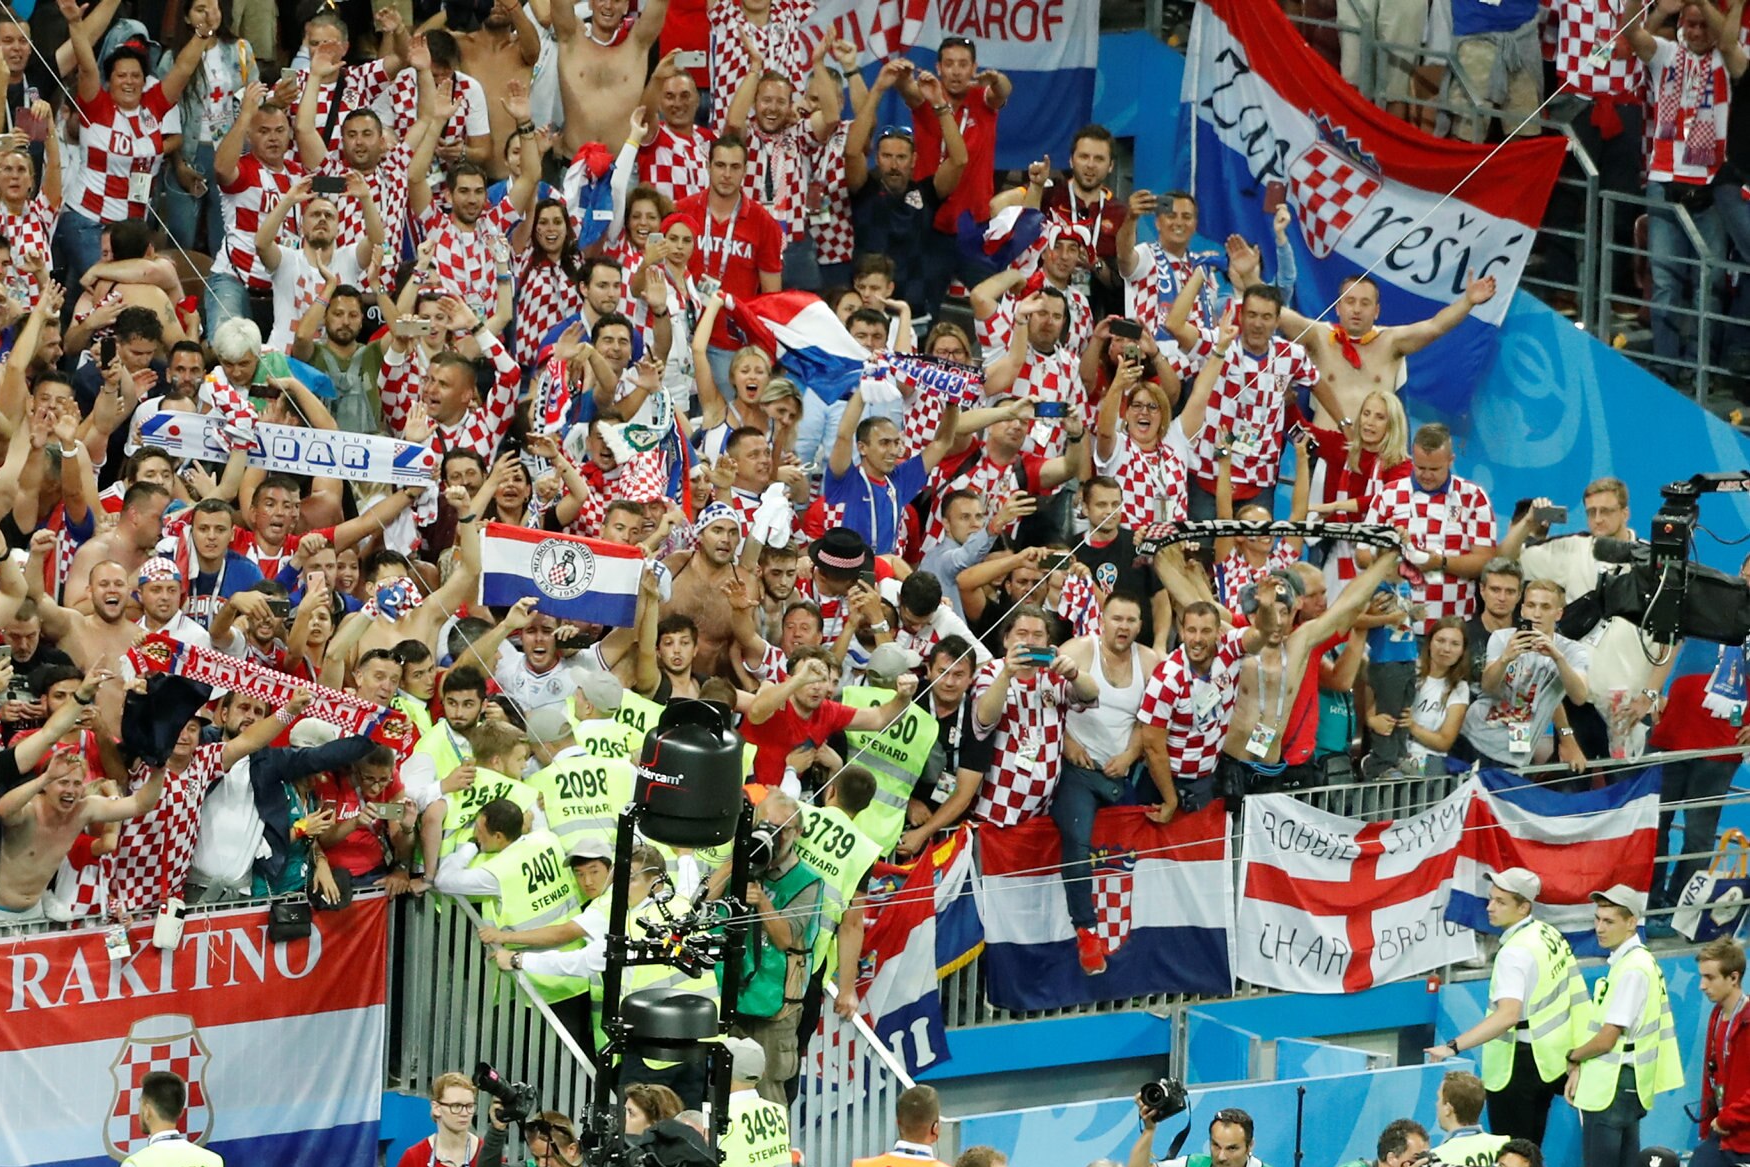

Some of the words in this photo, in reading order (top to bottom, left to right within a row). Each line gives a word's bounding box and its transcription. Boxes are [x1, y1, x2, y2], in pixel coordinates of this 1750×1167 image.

[113, 133, 131, 154] 10
[330, 434, 372, 446] KLUB
[327, 467, 369, 478] CLUB
[859, 734, 909, 763] STEWARD
[555, 767, 609, 801] 2098
[562, 803, 613, 817] STEWAR
[801, 811, 856, 860] 3739
[522, 846, 563, 894] 2407
[531, 883, 570, 912] STEWARD
[1682, 874, 1708, 908] VISA
[6, 914, 324, 1014] RAKITNO
[741, 1106, 788, 1145] 3495
[748, 1143, 793, 1165] STEWARD
